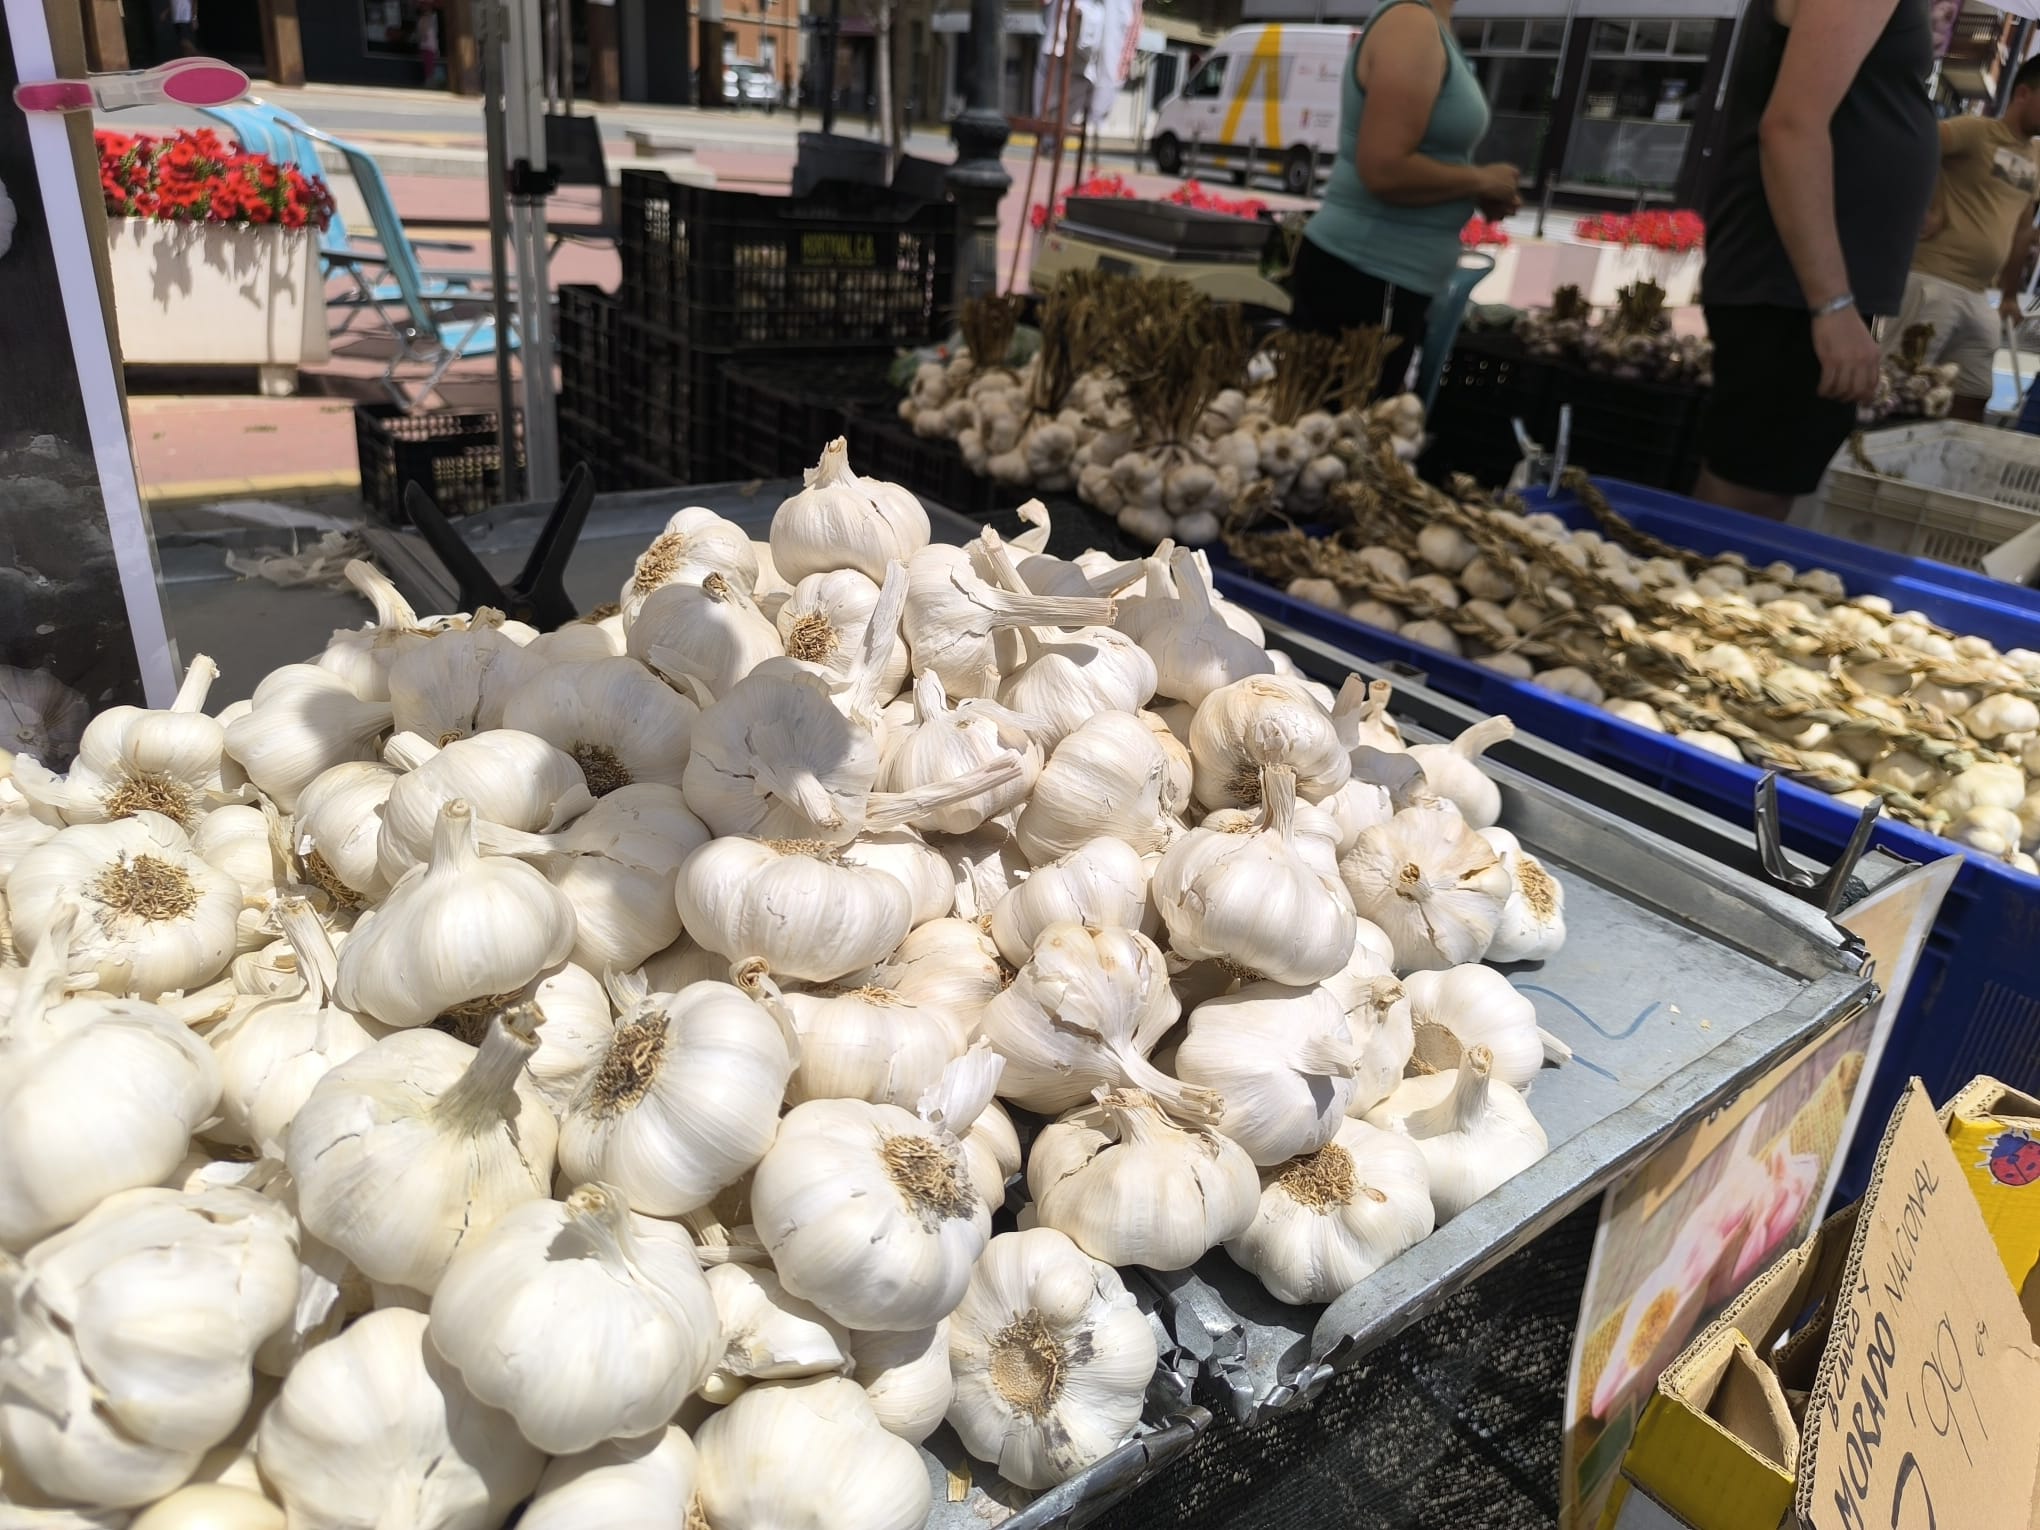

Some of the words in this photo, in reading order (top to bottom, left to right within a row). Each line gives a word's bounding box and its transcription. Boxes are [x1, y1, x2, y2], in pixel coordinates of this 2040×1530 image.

[1827, 1307, 1861, 1433] BLANCO
[1834, 1311, 1896, 1530] MORADO
[1884, 1159, 1940, 1318] NACIONAL
